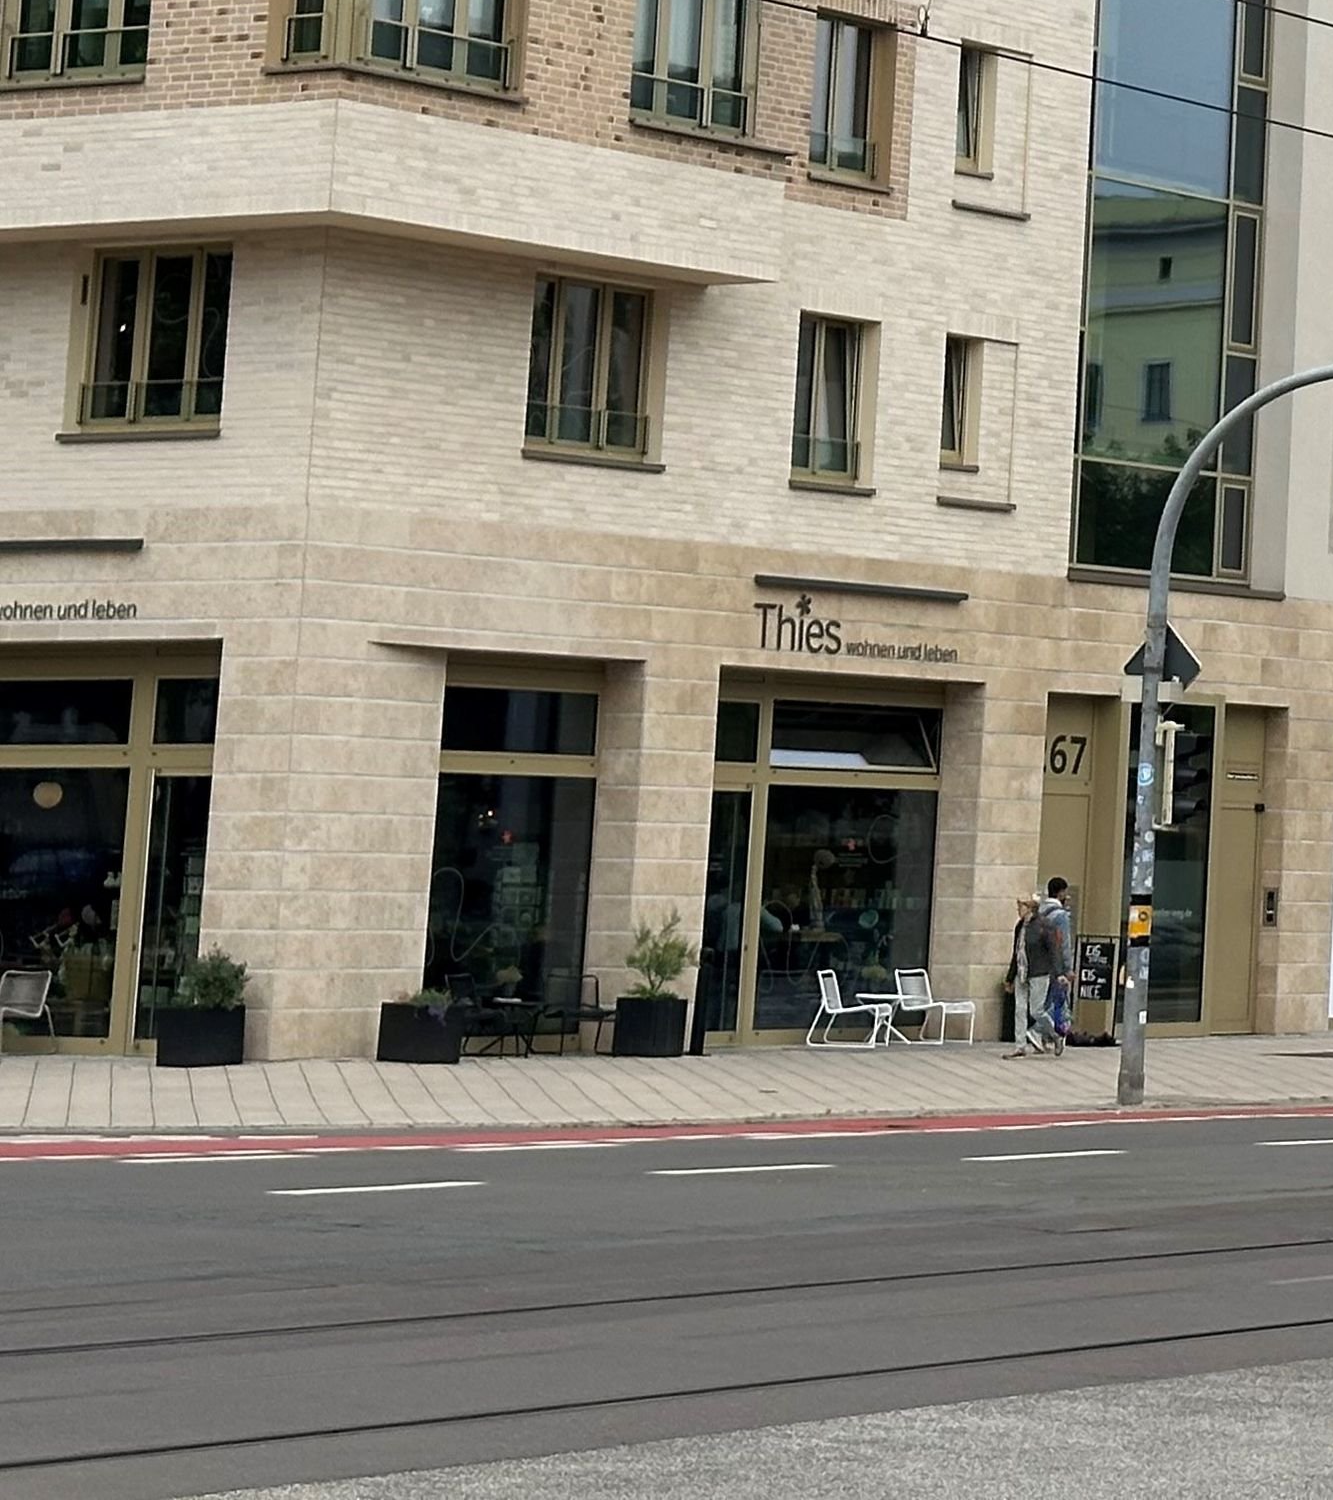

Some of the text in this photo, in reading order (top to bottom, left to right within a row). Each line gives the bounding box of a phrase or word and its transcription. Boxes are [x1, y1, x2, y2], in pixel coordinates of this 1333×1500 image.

[57, 598, 89, 621] und
[91, 598, 137, 620] leben
[753, 594, 958, 663] Thies wohnen und leben
[1044, 734, 1088, 775] 67
